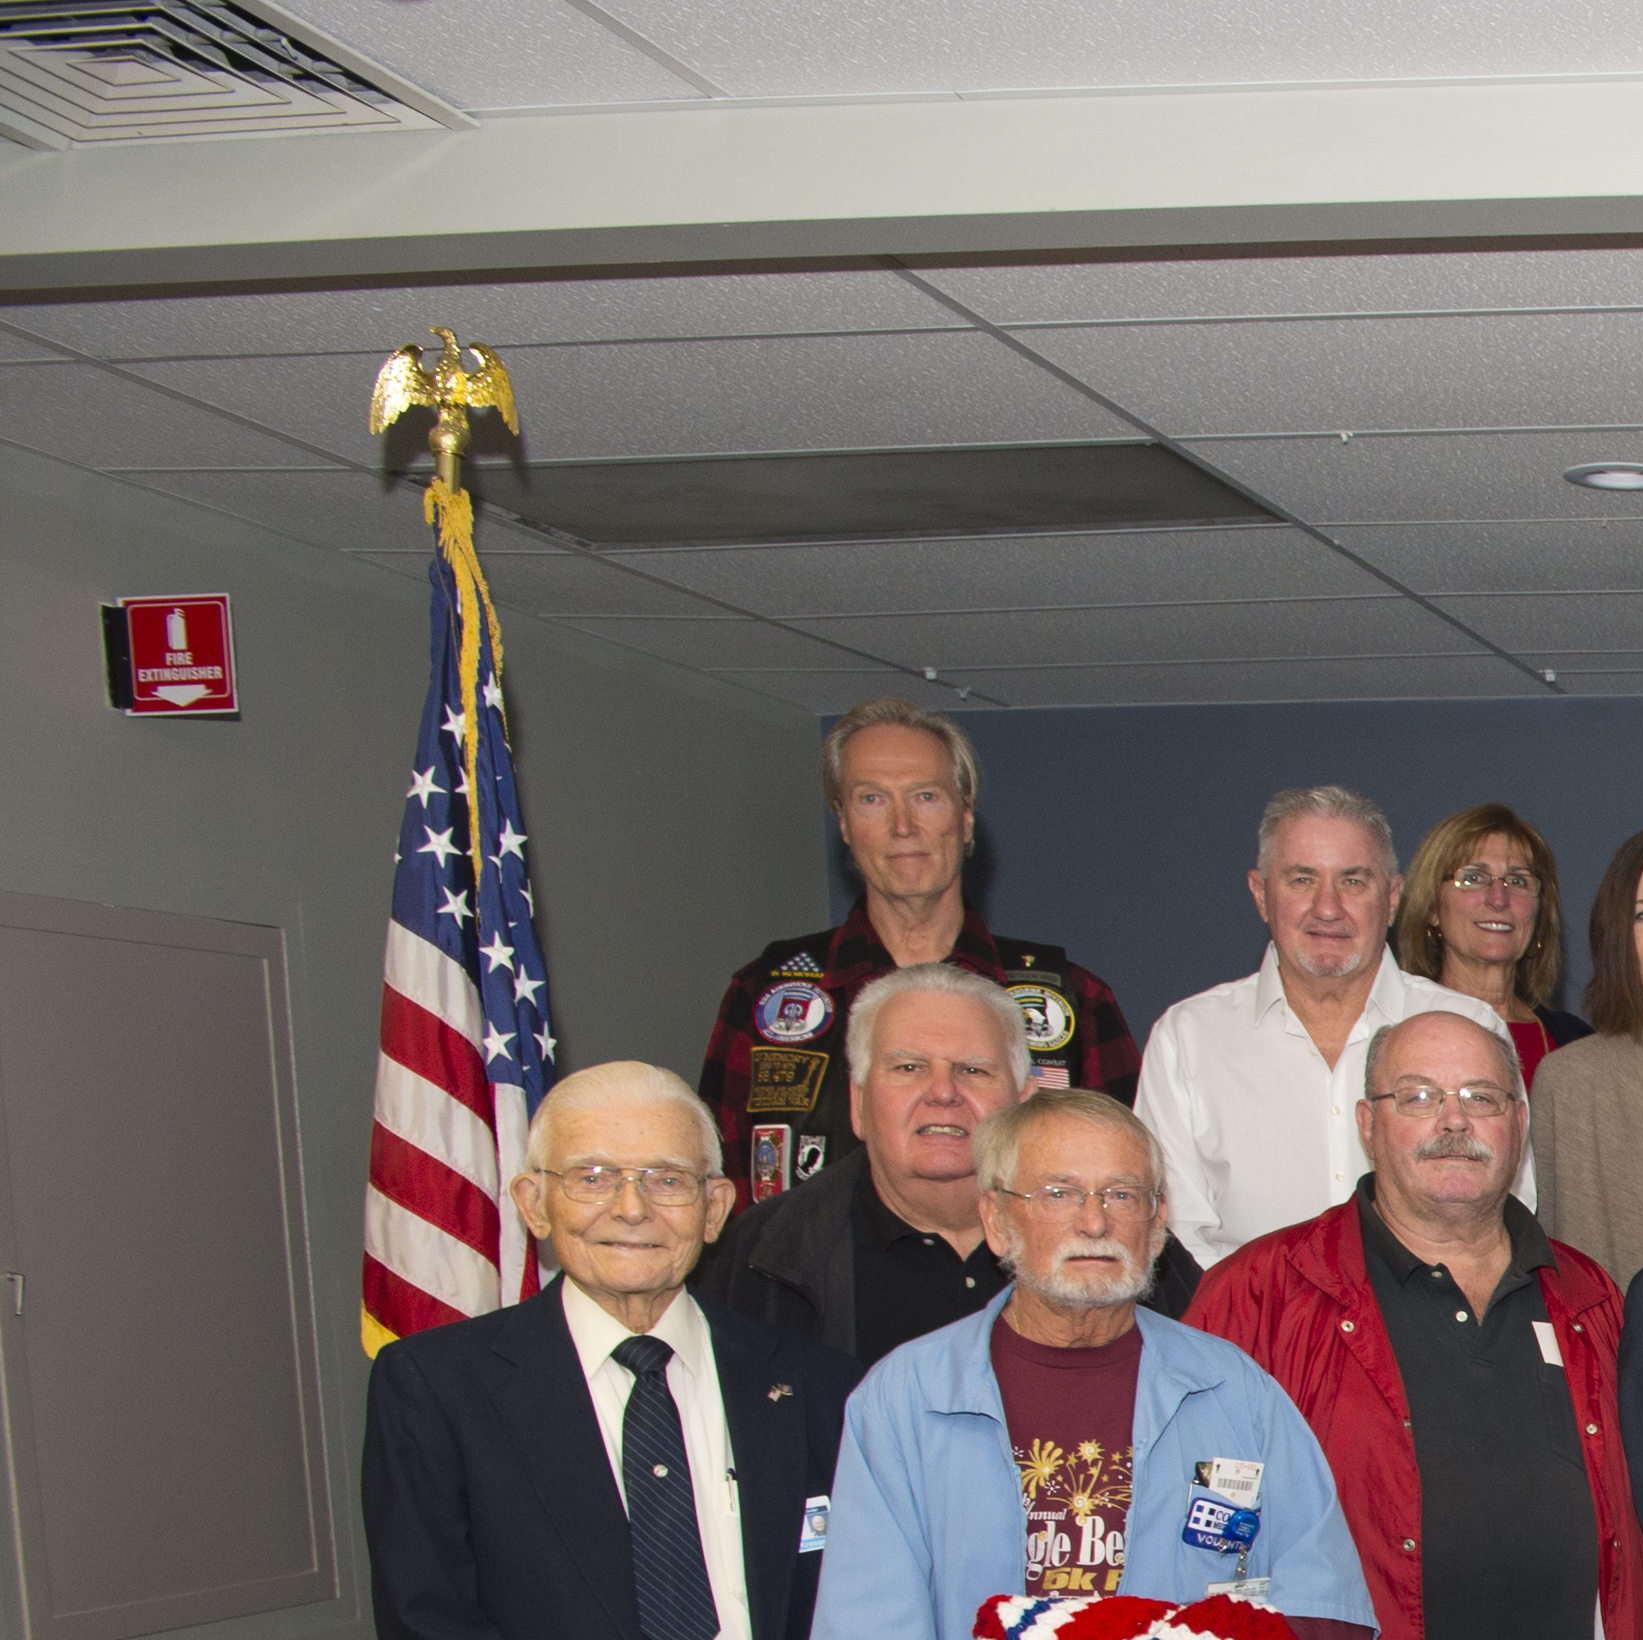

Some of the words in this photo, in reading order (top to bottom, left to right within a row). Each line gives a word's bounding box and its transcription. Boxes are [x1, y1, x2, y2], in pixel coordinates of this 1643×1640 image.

[165, 652, 194, 666] FIRE
[137, 666, 223, 682] EXTINGUISHER
[1043, 1567, 1098, 1590] 5k
